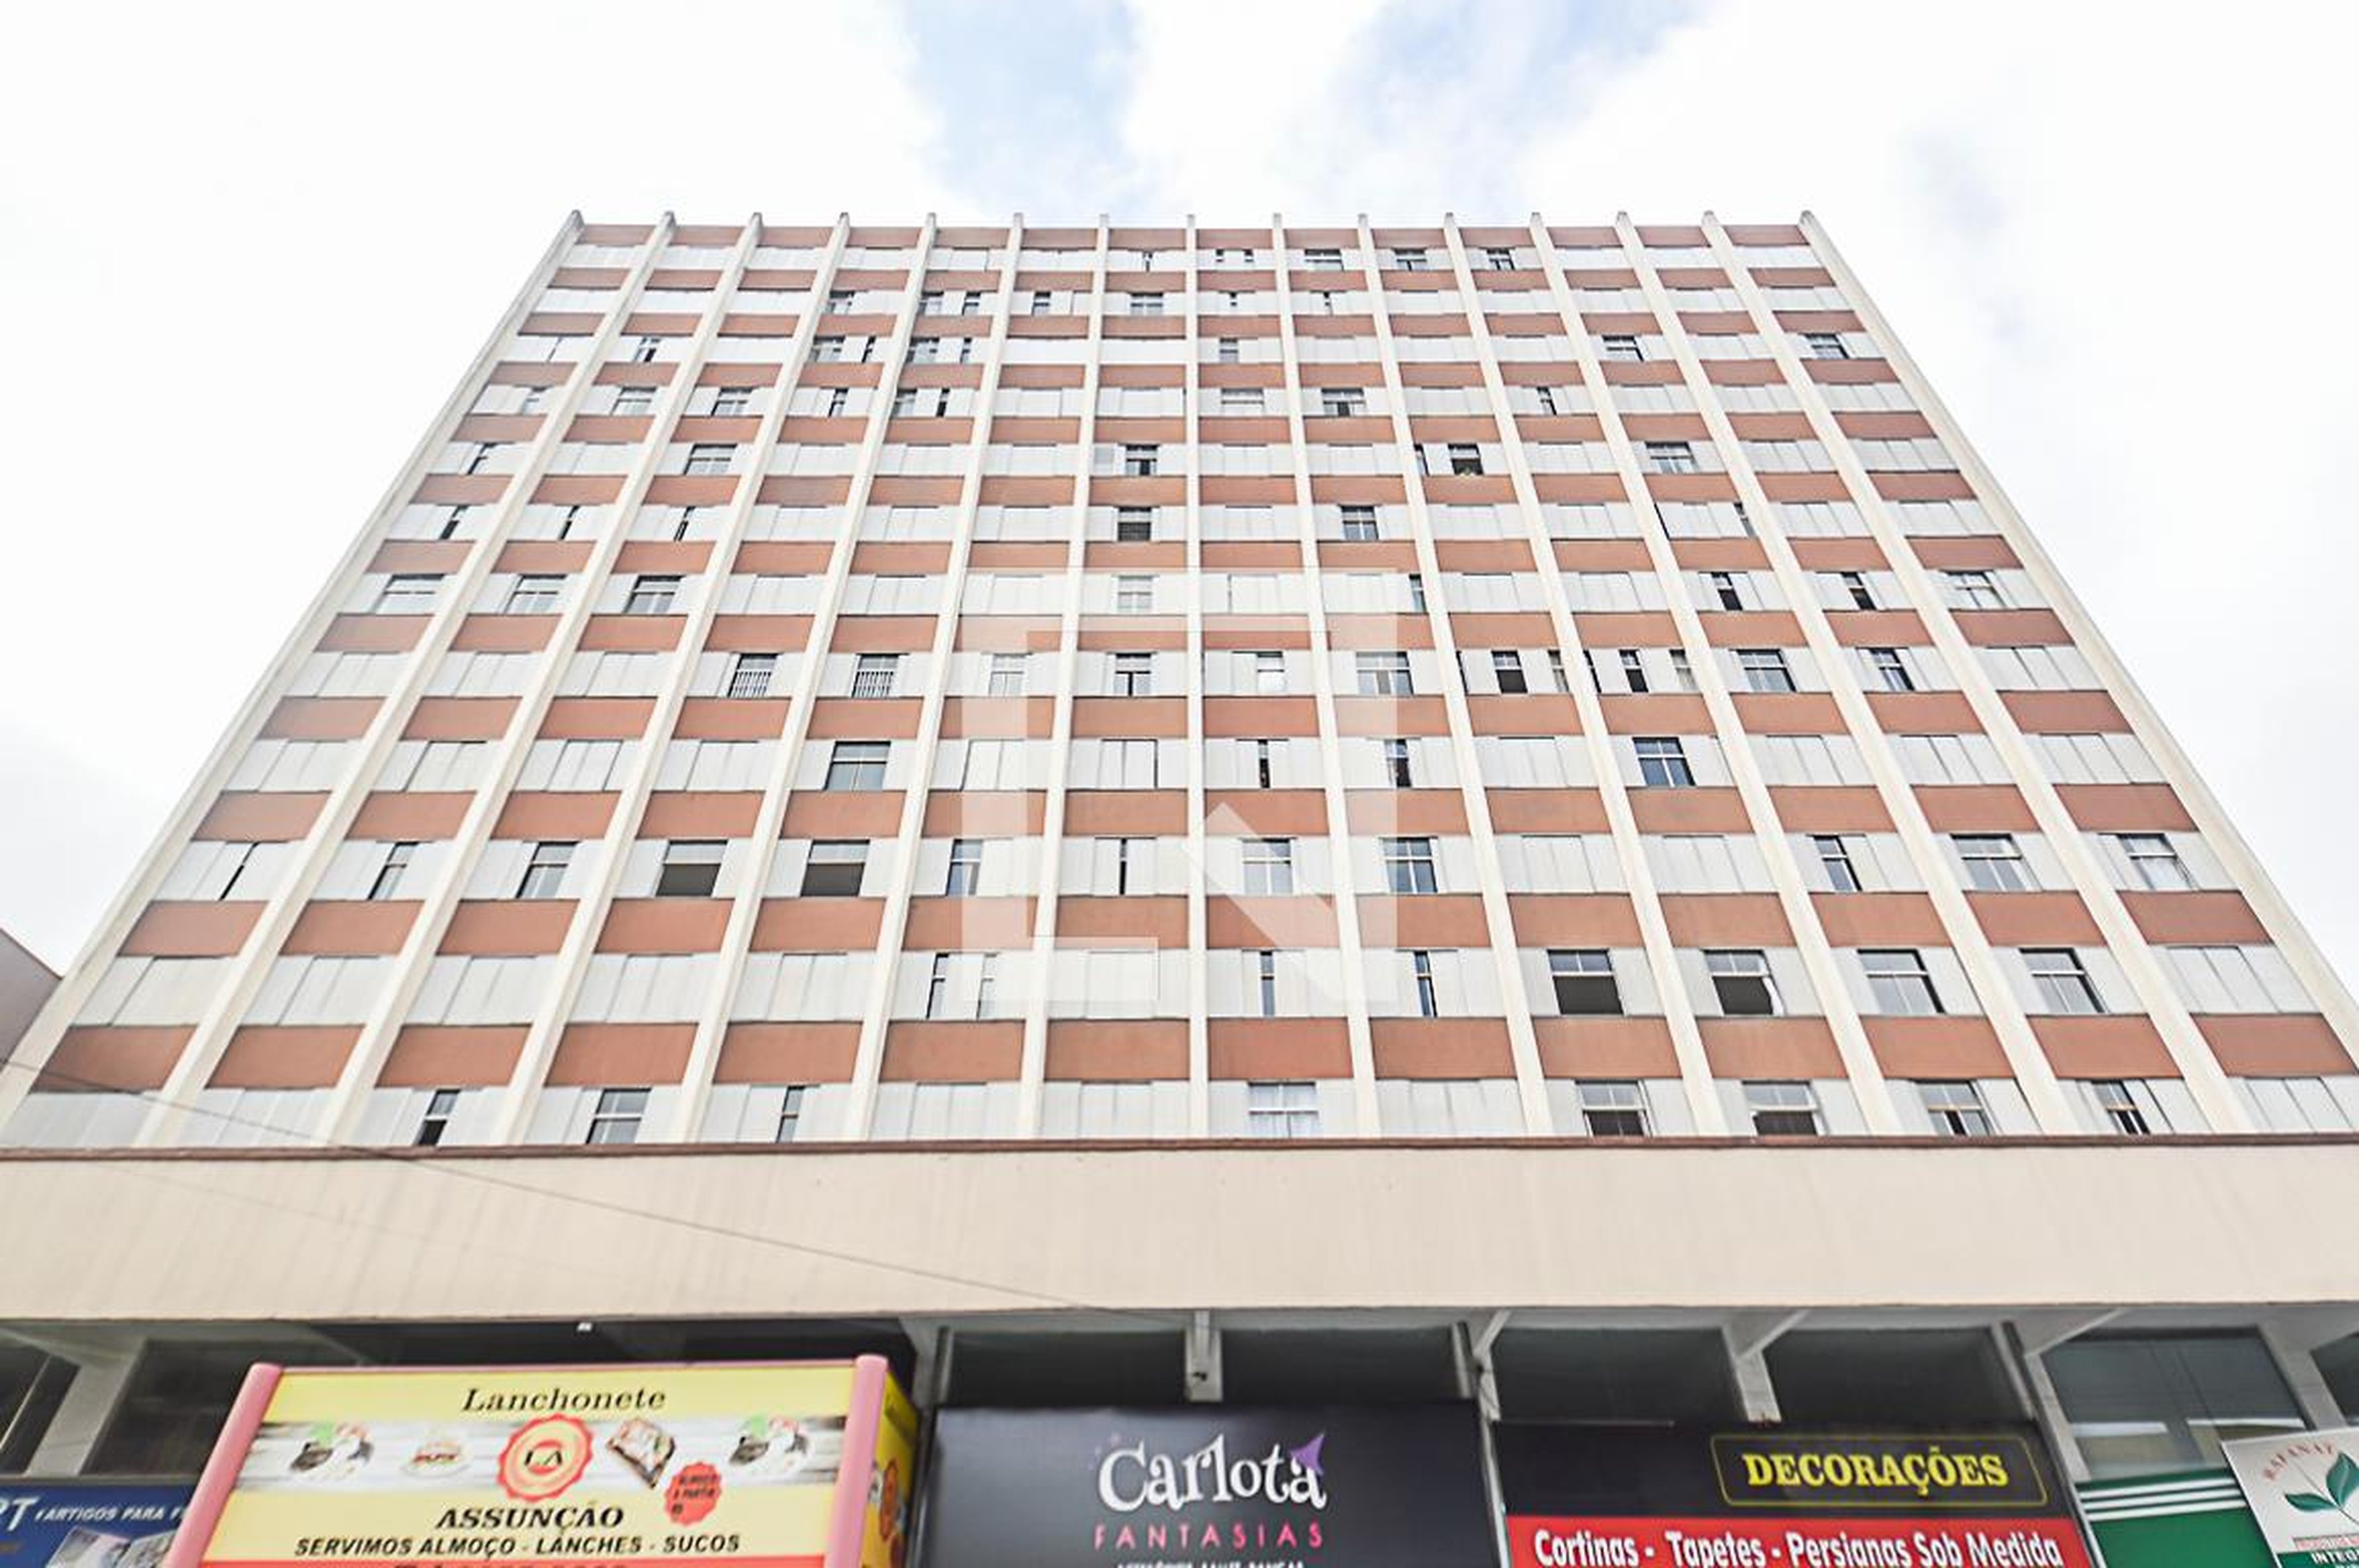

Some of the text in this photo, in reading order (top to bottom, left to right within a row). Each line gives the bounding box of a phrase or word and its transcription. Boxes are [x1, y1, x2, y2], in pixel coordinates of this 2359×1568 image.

[463, 1388, 665, 1411] Lanchonete
[1099, 1434, 1327, 1511] Carlota
[1743, 1446, 2009, 1496] DECORAÇÕES
[42, 1507, 117, 1521] ARTIGOS
[122, 1507, 165, 1520] PARA
[435, 1501, 624, 1534] ASSUNÇÃO
[295, 1538, 413, 1556] SERVIMOS
[418, 1537, 517, 1559] ALMOÇO
[536, 1537, 641, 1554] LANCHES
[663, 1534, 740, 1553] SUCOS
[1095, 1523, 1323, 1550] FANTASIAS
[1535, 1530, 1639, 1568] Cortinas
[1665, 1531, 1766, 1568] Tapetes
[1786, 1532, 1912, 1568] Persianas
[1913, 1532, 1963, 1568] Sob
[1966, 1532, 2064, 1568] Medida
